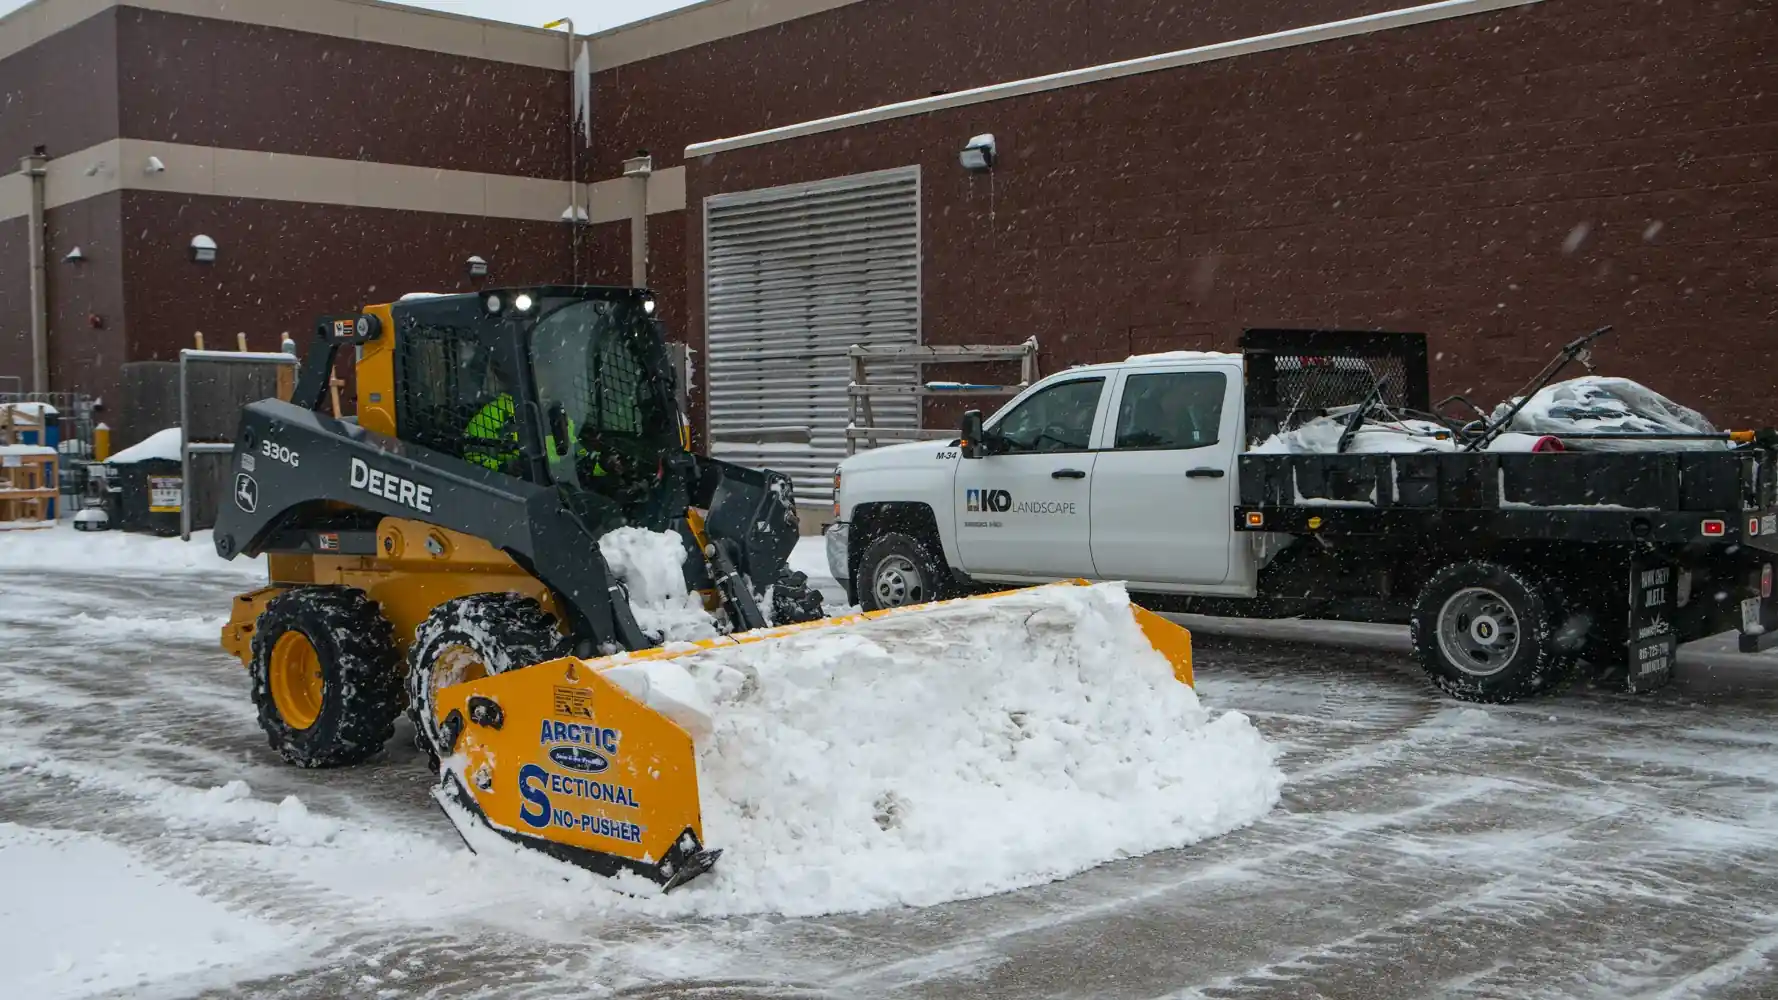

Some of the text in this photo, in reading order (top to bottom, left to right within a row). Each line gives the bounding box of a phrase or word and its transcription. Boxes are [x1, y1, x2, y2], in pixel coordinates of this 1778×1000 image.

[262, 440, 299, 468] 330G
[936, 452, 957, 460] M-34
[350, 457, 432, 513] DEERE
[1012, 501, 1076, 514] LANDSCAPE
[540, 719, 618, 755] ARCTIC
